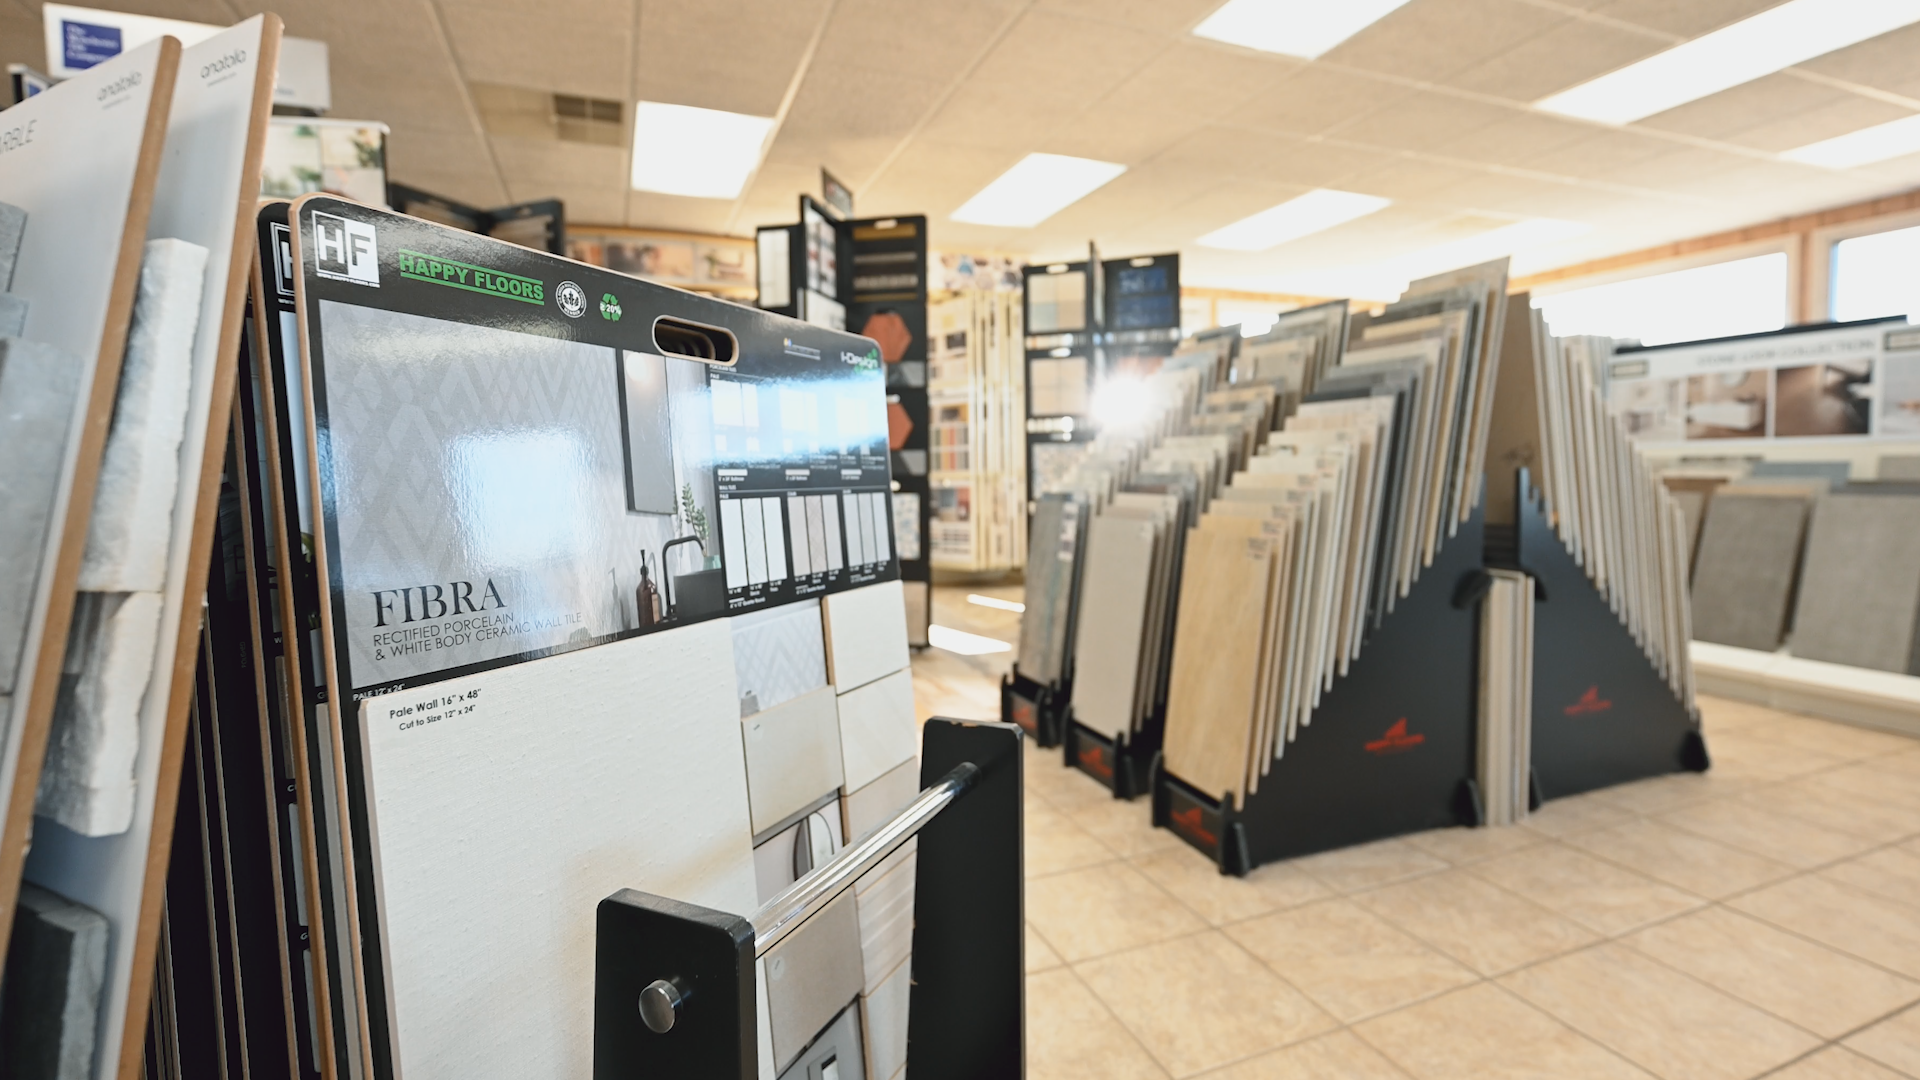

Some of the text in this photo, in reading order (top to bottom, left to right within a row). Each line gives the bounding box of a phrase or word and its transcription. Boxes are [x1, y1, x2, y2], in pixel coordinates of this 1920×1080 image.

[317, 224, 371, 267] HF
[400, 254, 544, 300] HAPPY FLOORS
[371, 577, 507, 628] FIBRA
[373, 612, 515, 647] RECTIFIED PORCELAIN
[375, 612, 582, 661] & WHITE BODY CERAMIC WALL TILE
[389, 688, 482, 720] Pale Wall 16" x 48"
[399, 719, 415, 732] Cut
[416, 717, 425, 727] to
[427, 712, 442, 724] Size
[444, 709, 457, 719] 12"
[464, 704, 476, 715] 24"
